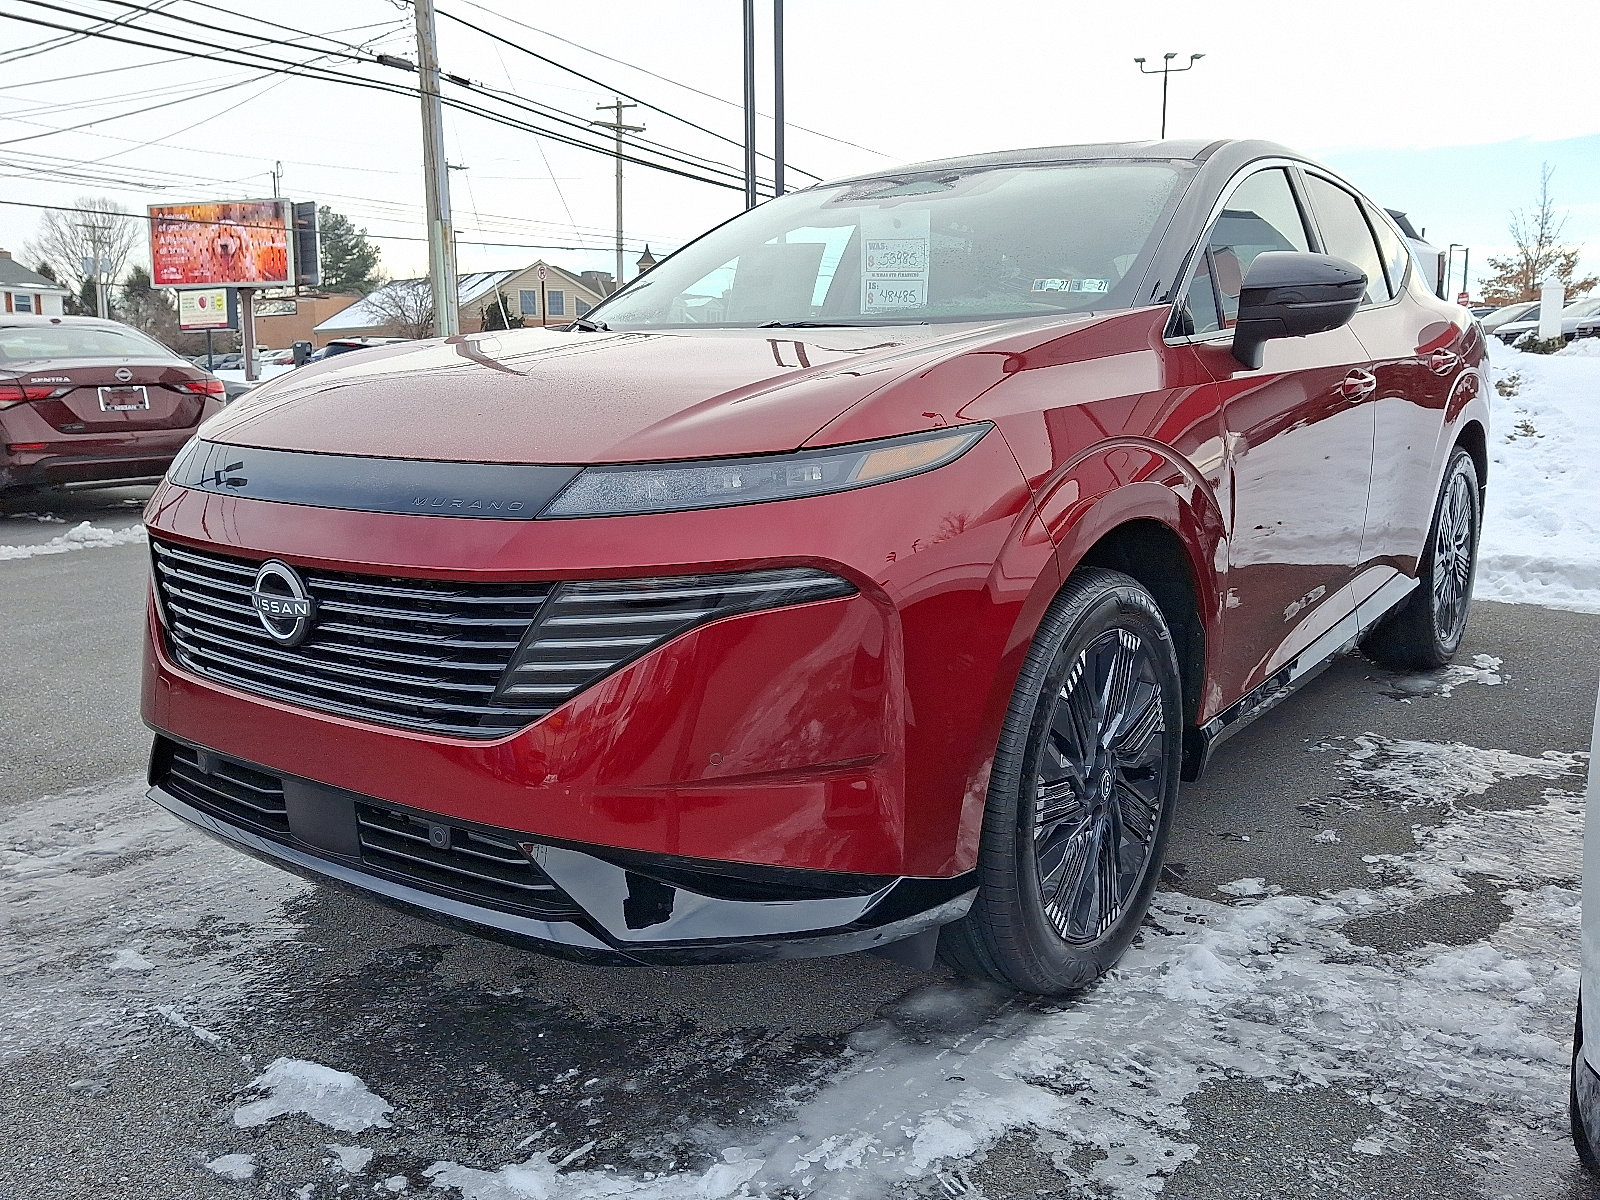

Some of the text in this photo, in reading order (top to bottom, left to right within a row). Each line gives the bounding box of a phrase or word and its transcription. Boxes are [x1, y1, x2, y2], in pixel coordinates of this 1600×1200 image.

[868, 282, 879, 290] IS:
[1059, 281, 1069, 290] 27
[1097, 281, 1108, 291] 27
[879, 289, 917, 303] 48485
[30, 376, 71, 384] SENTRA
[411, 497, 525, 511] MURANO
[251, 594, 308, 615] NISSAN
